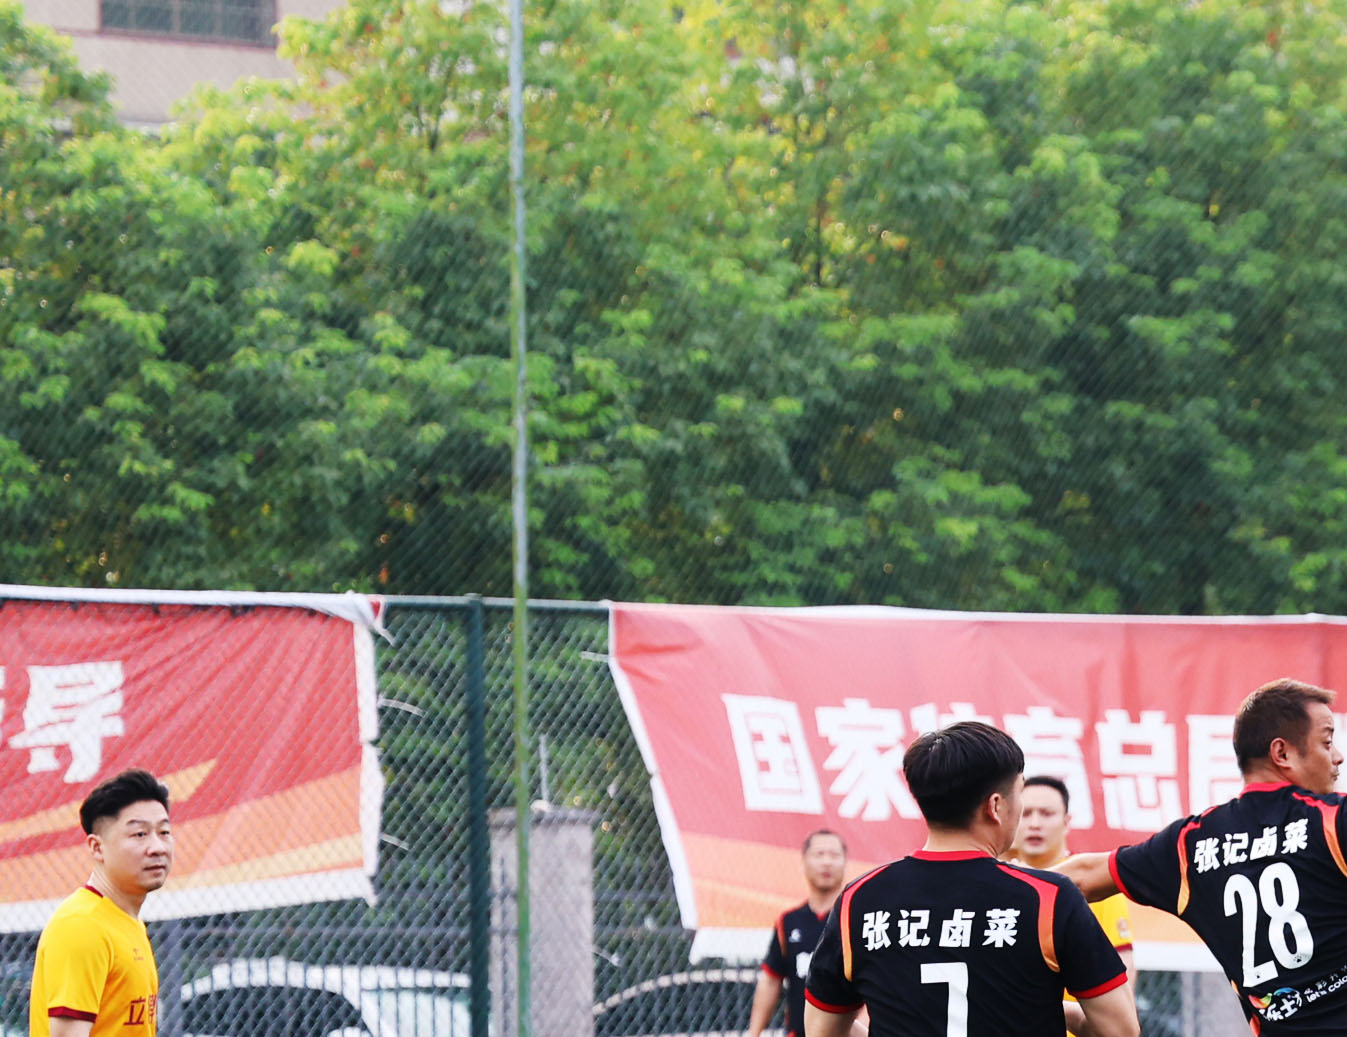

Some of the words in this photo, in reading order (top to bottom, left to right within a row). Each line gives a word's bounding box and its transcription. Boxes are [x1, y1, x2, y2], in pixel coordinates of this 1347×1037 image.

[0, 660, 125, 783] 导
[1194, 818, 1309, 873] 张记卤菜
[862, 908, 1021, 951] 张记卤菜
[1223, 862, 1314, 987] 28
